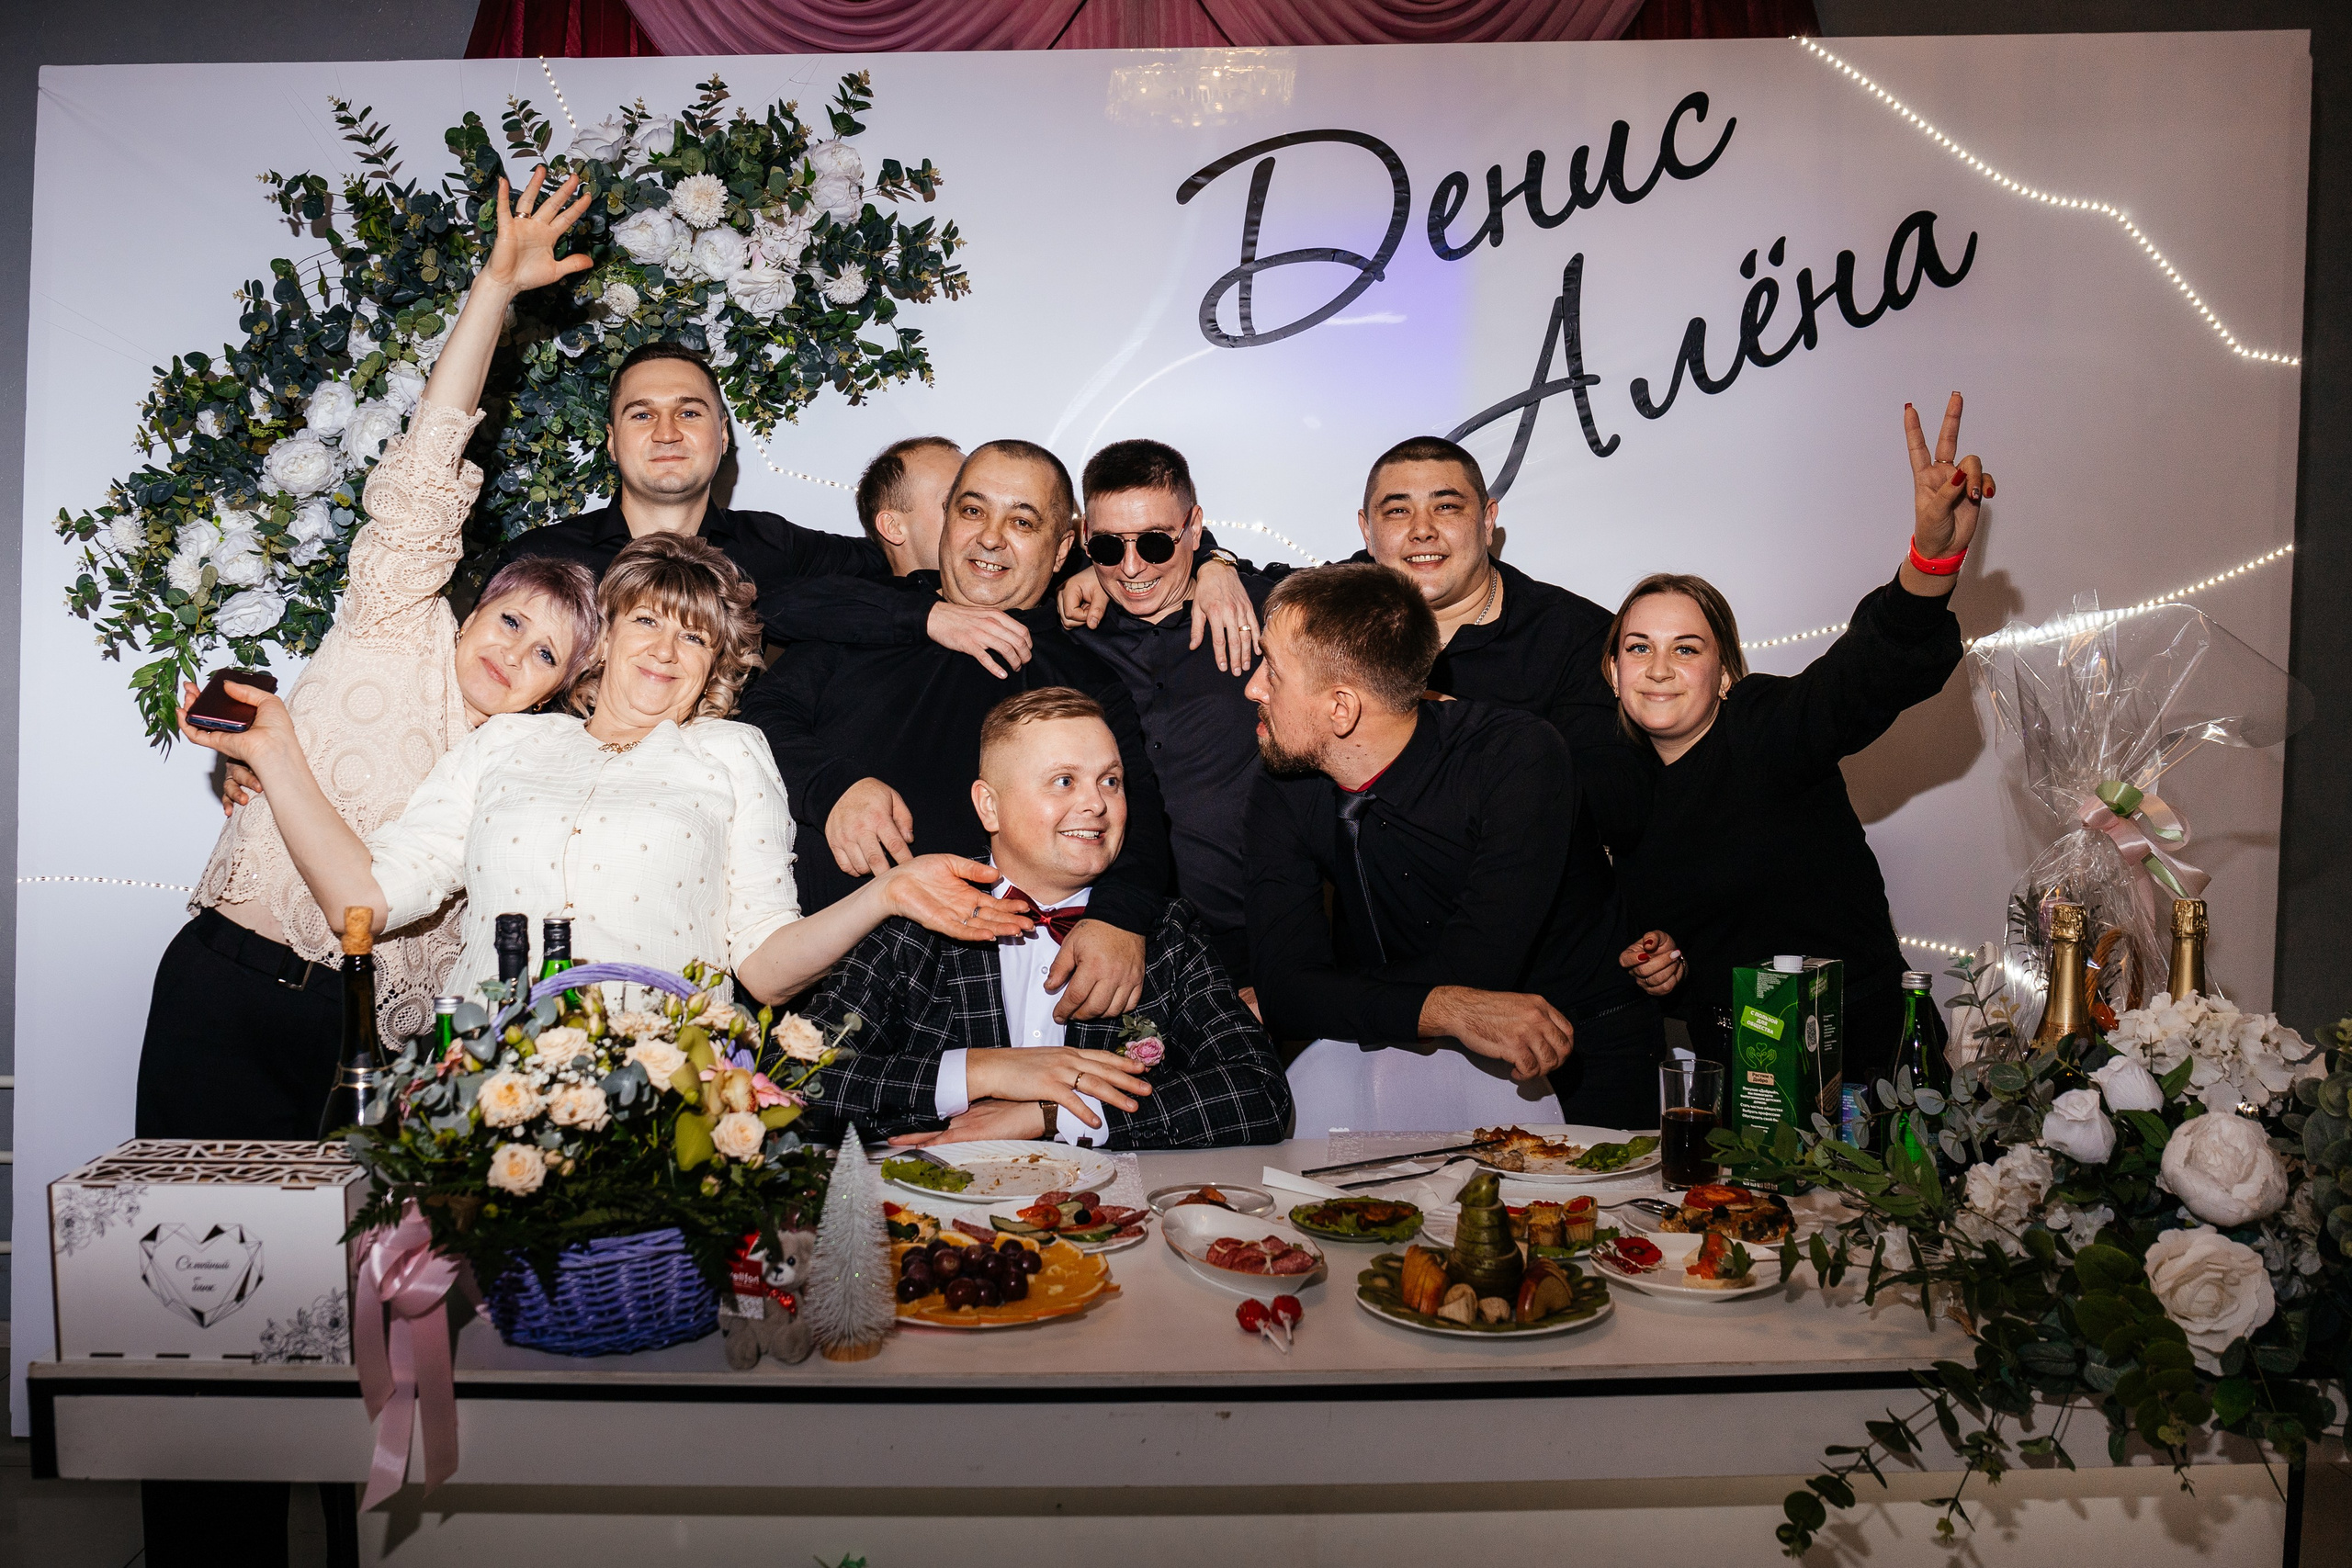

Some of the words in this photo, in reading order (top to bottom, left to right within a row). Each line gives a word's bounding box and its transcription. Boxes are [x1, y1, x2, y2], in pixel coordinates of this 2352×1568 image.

[1176, 91, 1737, 349] Денис
[1443, 209, 1978, 502] Алёна
[1755, 1011, 1779, 1025] ПОЛЬЗОЙ
[1756, 1018, 1769, 1026] ДЛЯ
[1747, 1020, 1774, 1035] ОБЩЕСТВА
